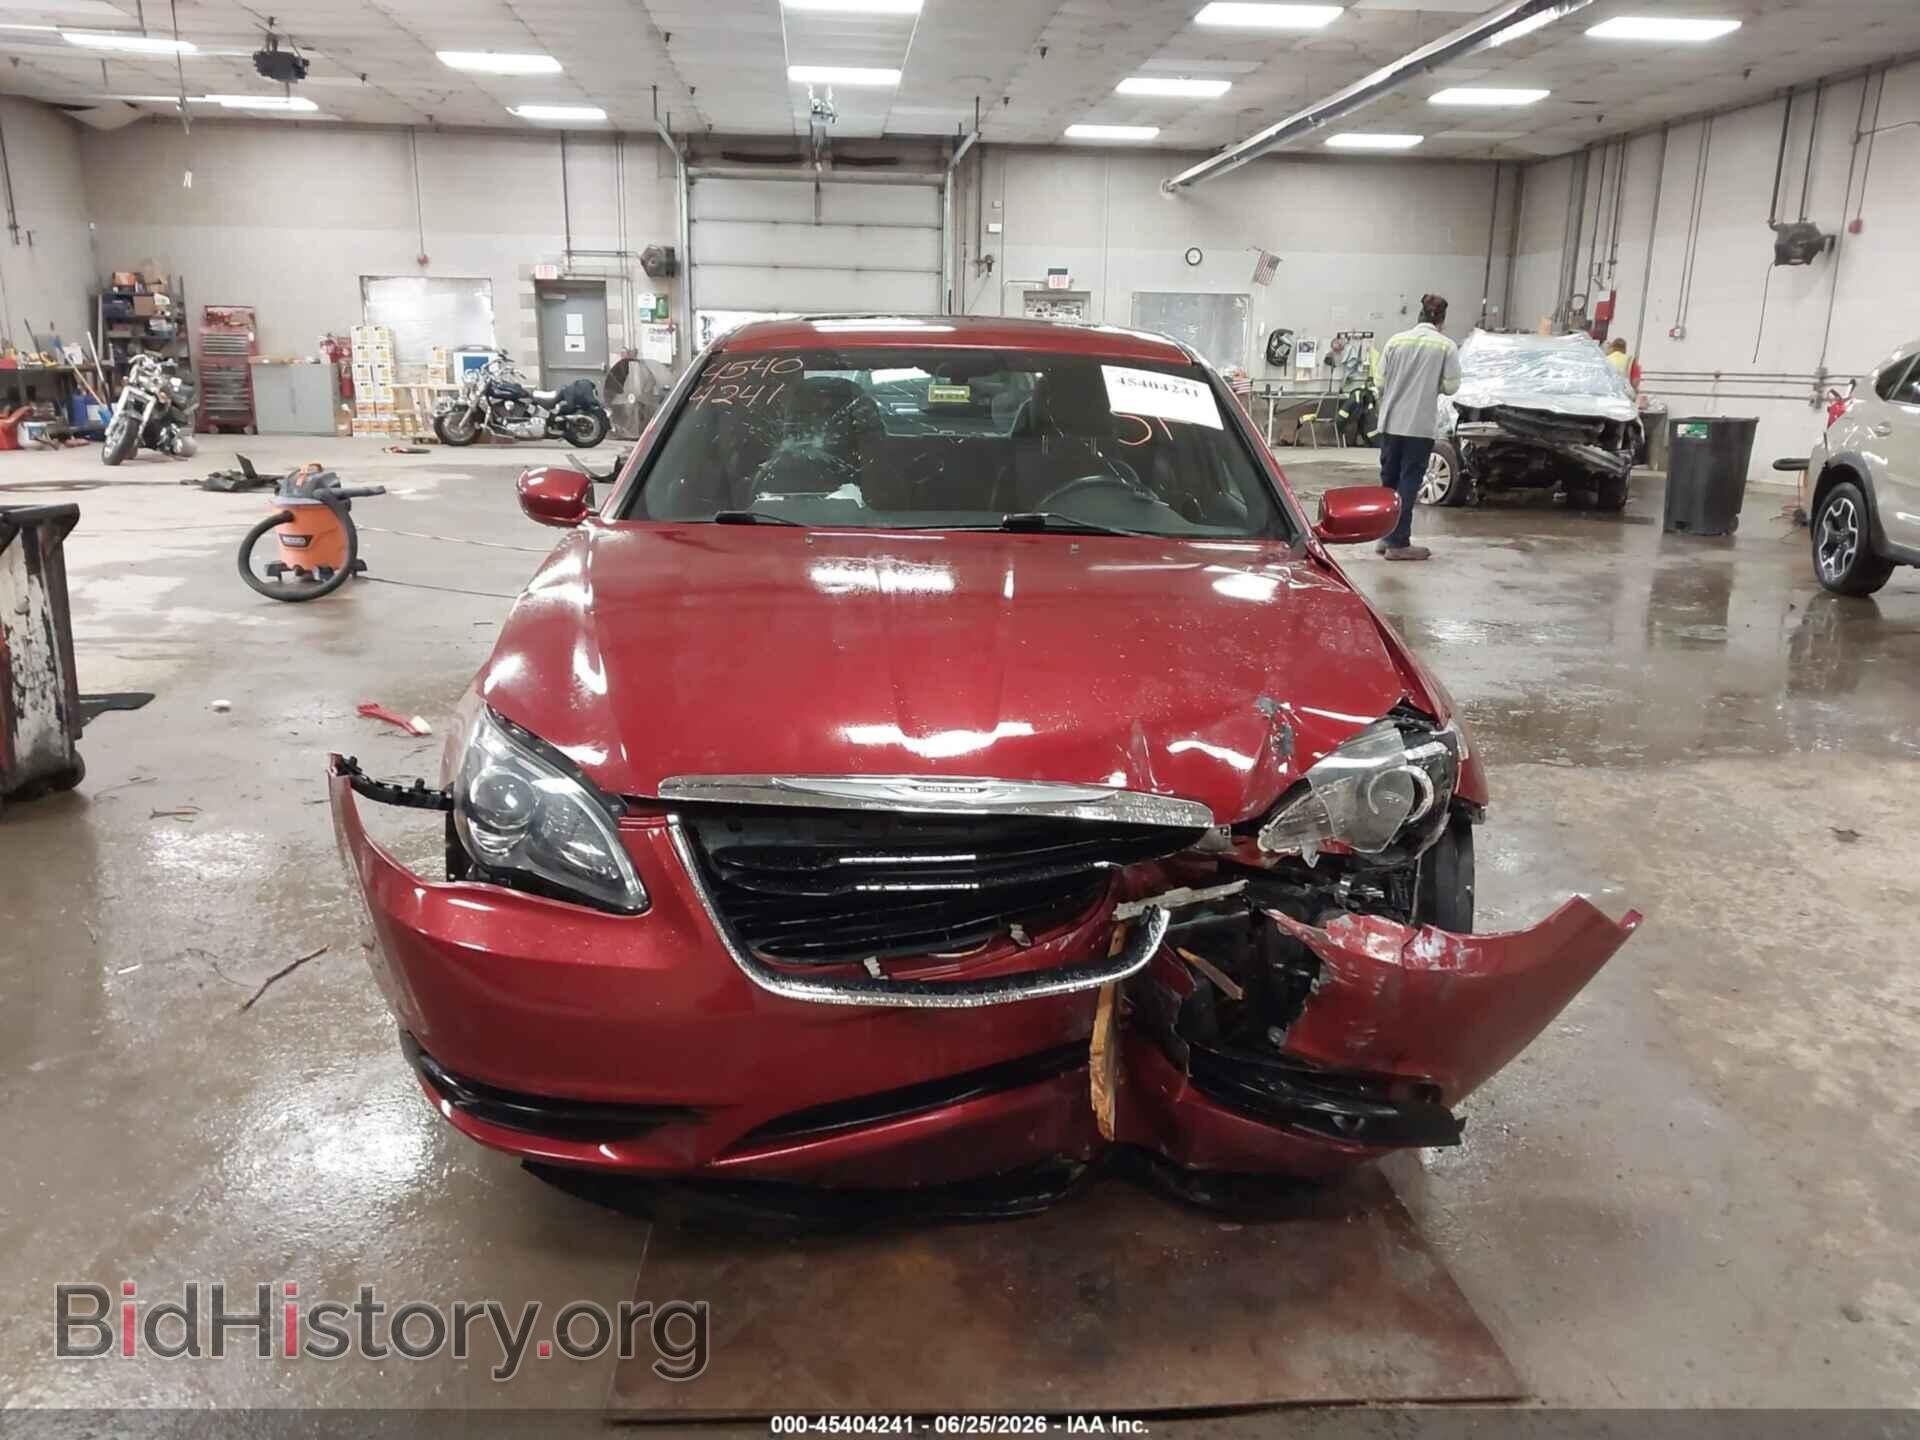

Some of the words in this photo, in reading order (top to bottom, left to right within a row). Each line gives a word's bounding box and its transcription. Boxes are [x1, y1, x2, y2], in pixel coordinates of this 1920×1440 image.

[701, 358, 804, 383] 4540
[689, 383, 785, 410] 4241
[1116, 376, 1200, 398] 45404241
